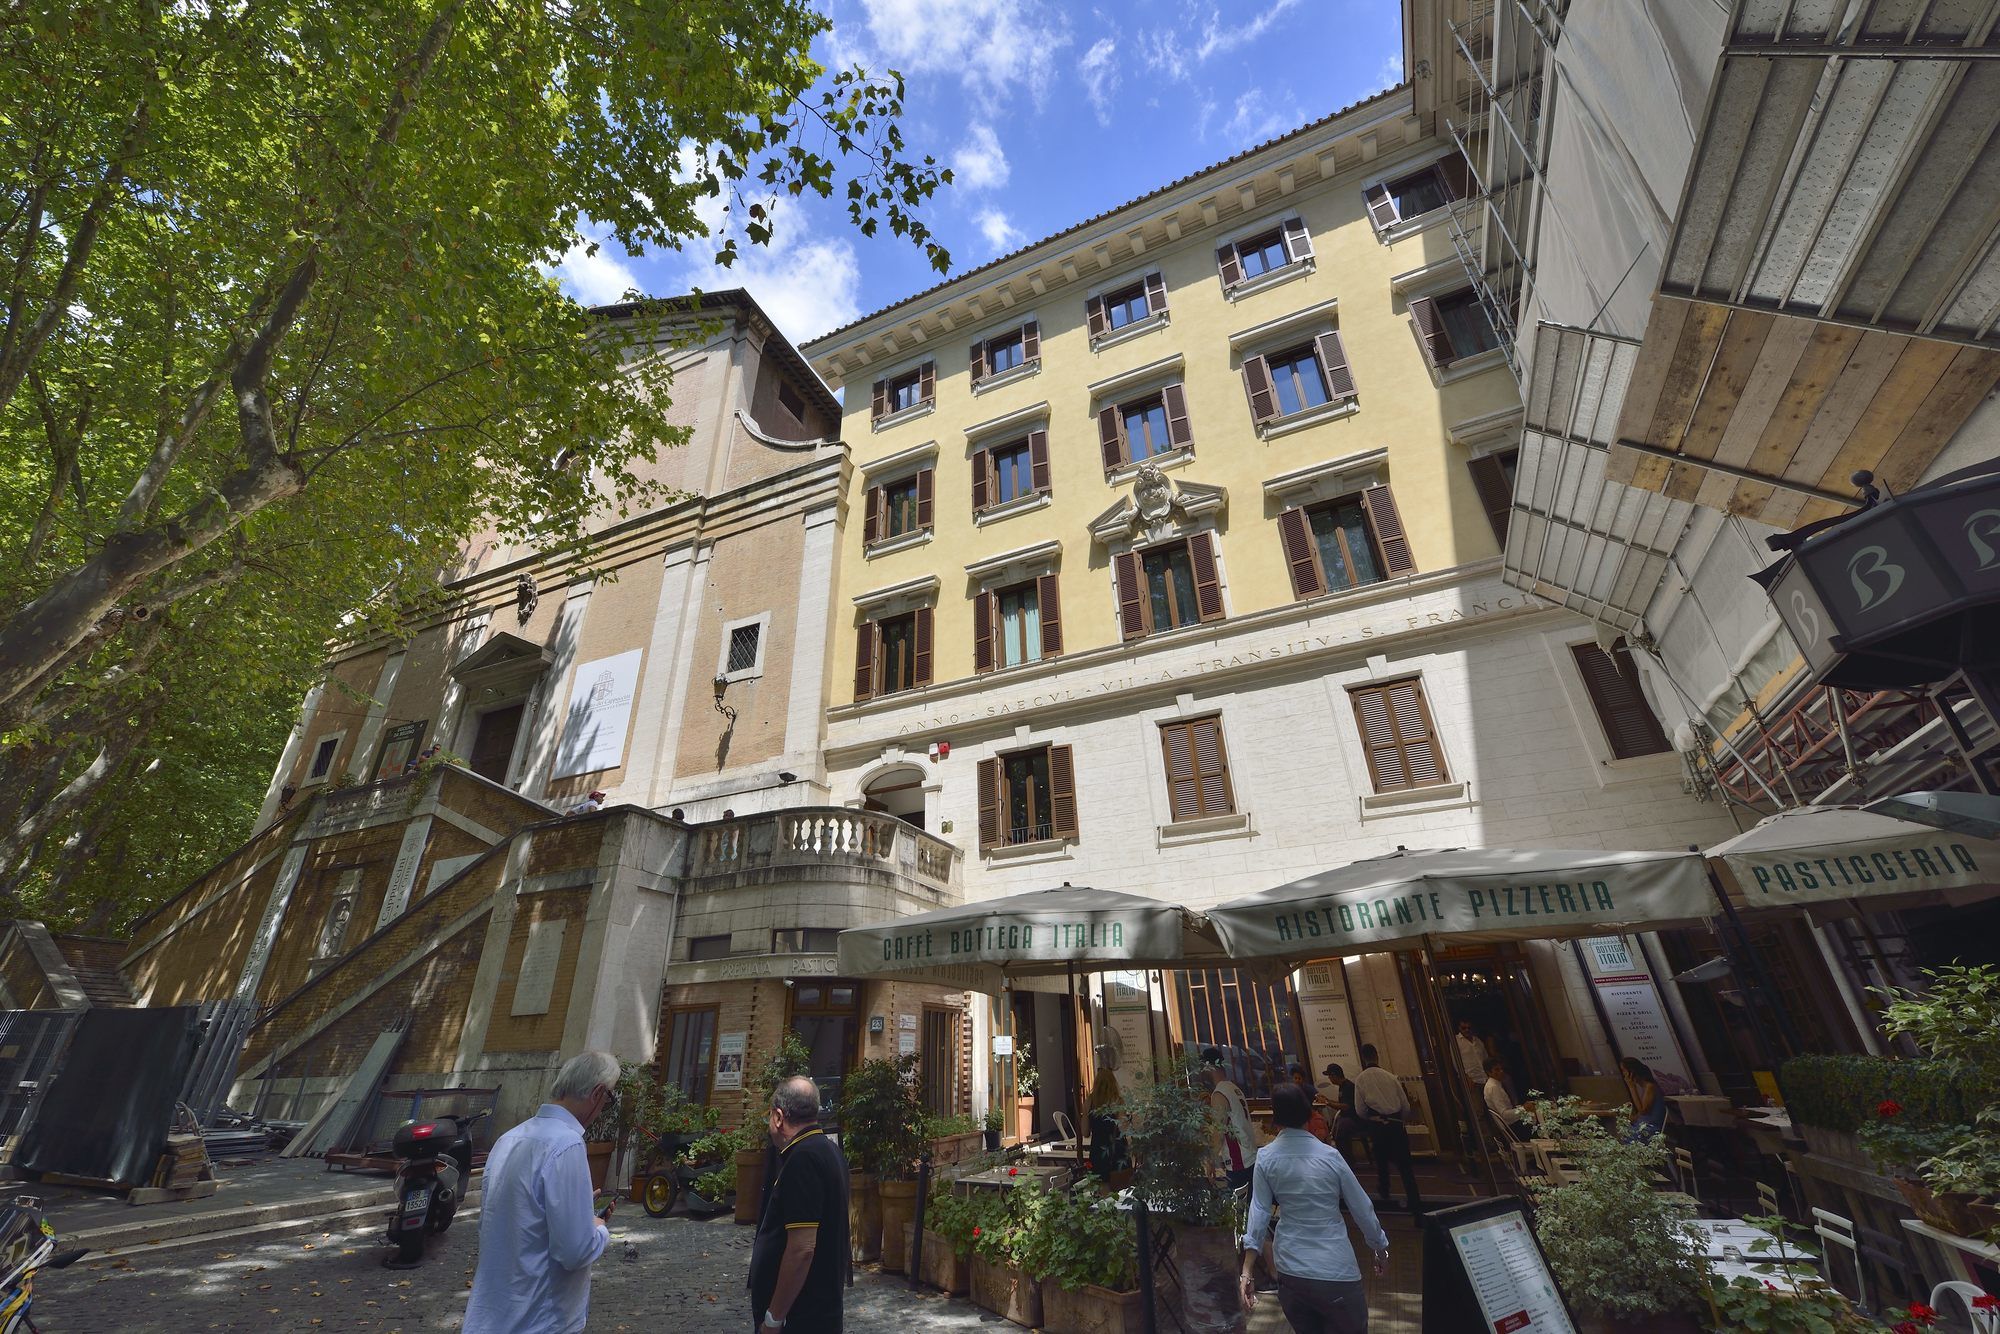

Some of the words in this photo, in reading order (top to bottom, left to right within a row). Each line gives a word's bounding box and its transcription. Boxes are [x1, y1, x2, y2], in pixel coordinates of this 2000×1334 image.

[1847, 545, 1906, 616] B
[1791, 589, 1820, 651] B
[899, 714, 960, 735] ANNO
[987, 690, 1076, 717] SAECVL
[1101, 678, 1136, 692] VII
[1161, 670, 1175, 682] A
[1196, 636, 1331, 673] TRANSITV
[1752, 843, 1980, 894] PASTICCERIA
[381, 856, 407, 921] Cappuccini
[1276, 892, 1445, 941] RISTORANTE
[1468, 880, 1615, 918] PIZZERIA
[883, 929, 933, 961] CAFFÈ
[951, 925, 1033, 954] BOTTEGA
[1053, 922, 1122, 949] ITALIA
[1596, 944, 1625, 954] BOTTEGA
[1599, 953, 1628, 965] ITALIA
[720, 960, 773, 978] PREMIATA
[1307, 974, 1331, 985] ITALIA
[1117, 987, 1136, 997] ITALIA
[872, 1020, 882, 1028] 23
